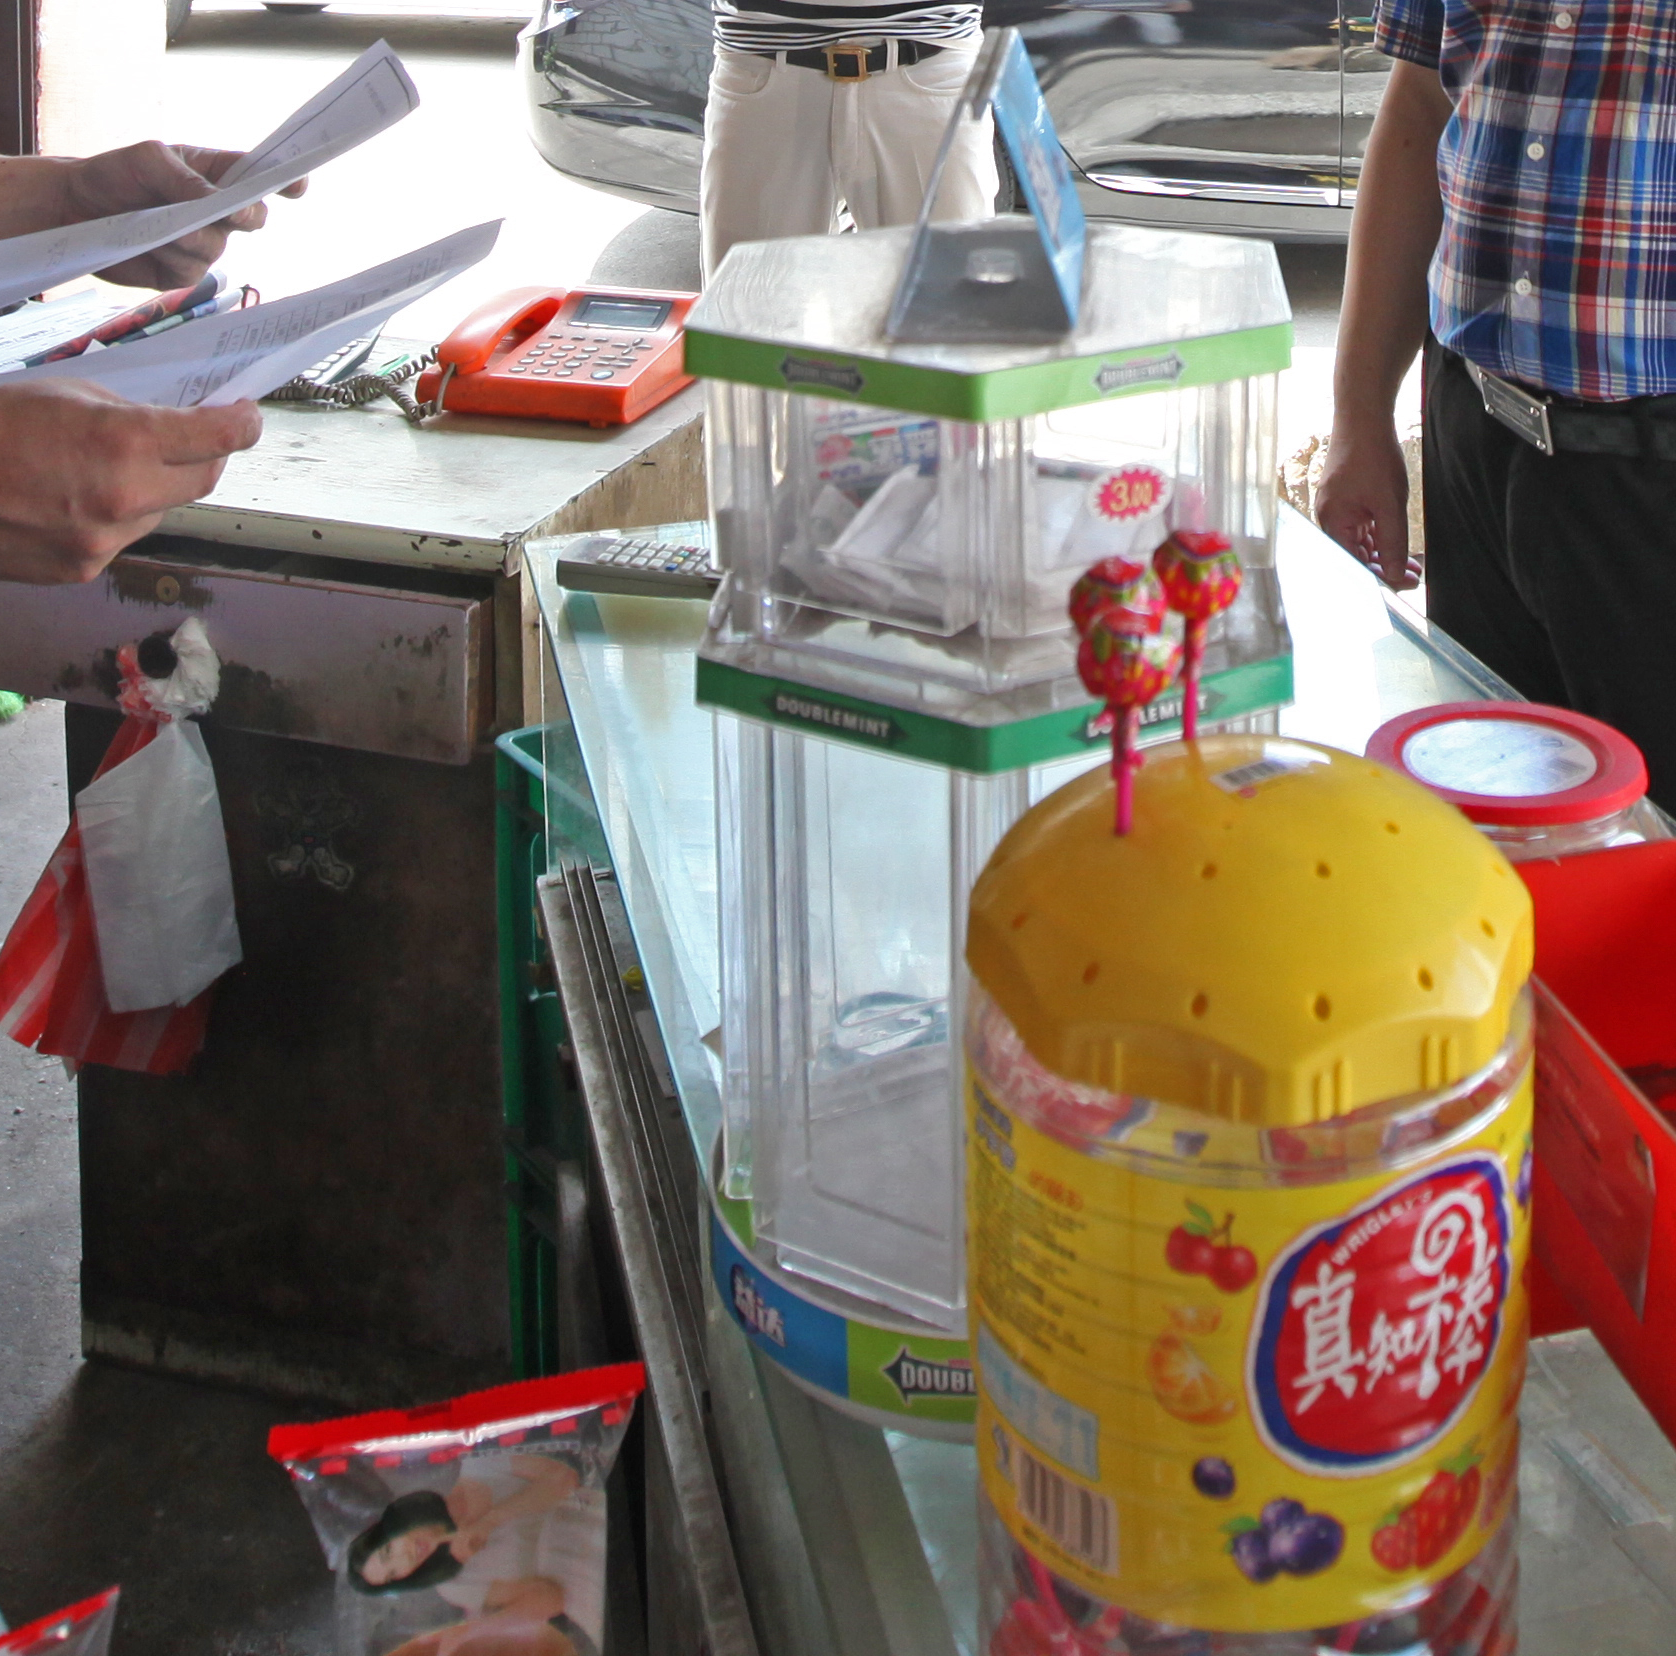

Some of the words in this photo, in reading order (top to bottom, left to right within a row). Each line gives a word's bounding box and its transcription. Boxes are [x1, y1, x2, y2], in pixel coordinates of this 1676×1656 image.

[1108, 479, 1155, 513] 3.00
[775, 694, 891, 739] DOUBLEMINT
[1290, 1220, 1497, 1417] 真知棒
